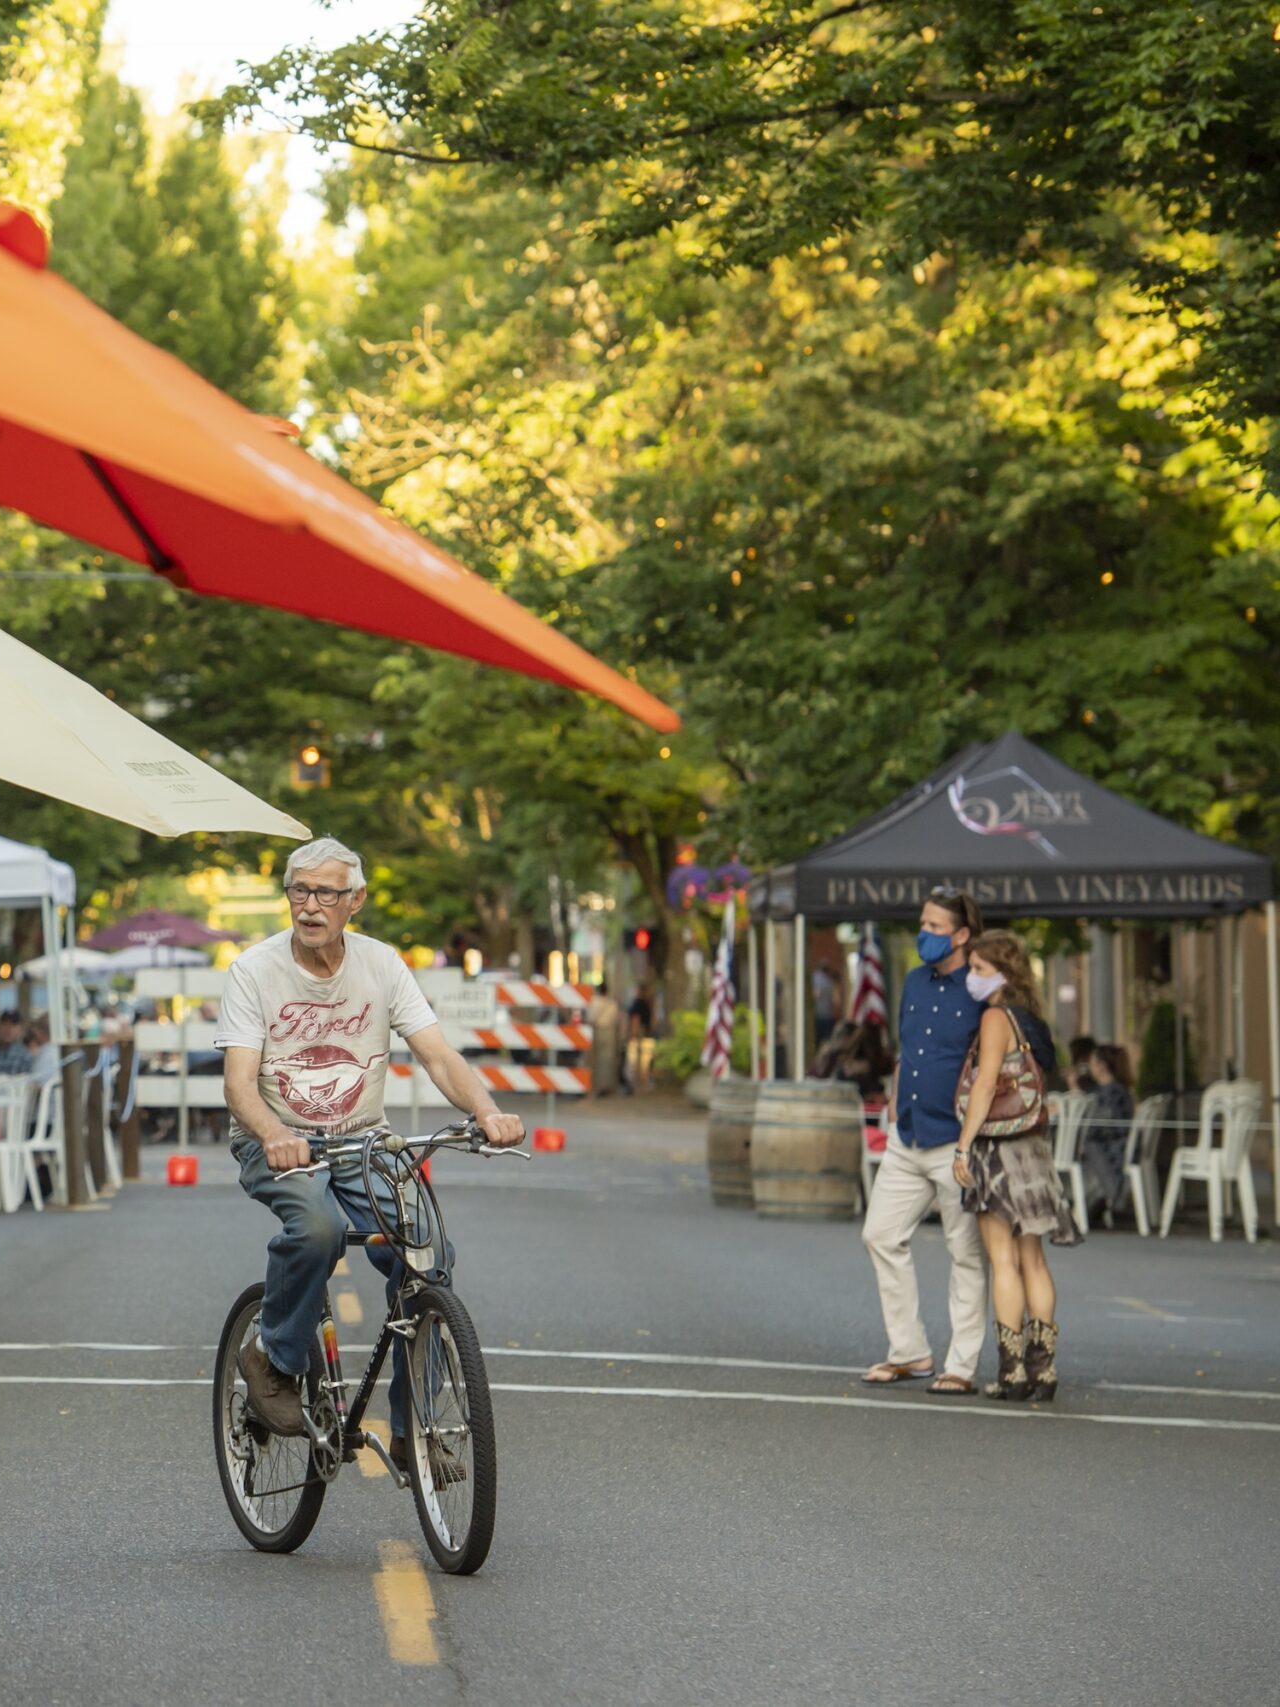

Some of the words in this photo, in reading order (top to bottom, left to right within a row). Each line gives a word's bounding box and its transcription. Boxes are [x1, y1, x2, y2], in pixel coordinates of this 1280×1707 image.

[826, 876, 926, 905] PINOT
[941, 875, 1038, 904] VISTA
[1055, 874, 1245, 903] VINEYARDS
[269, 998, 372, 1043] Ford
